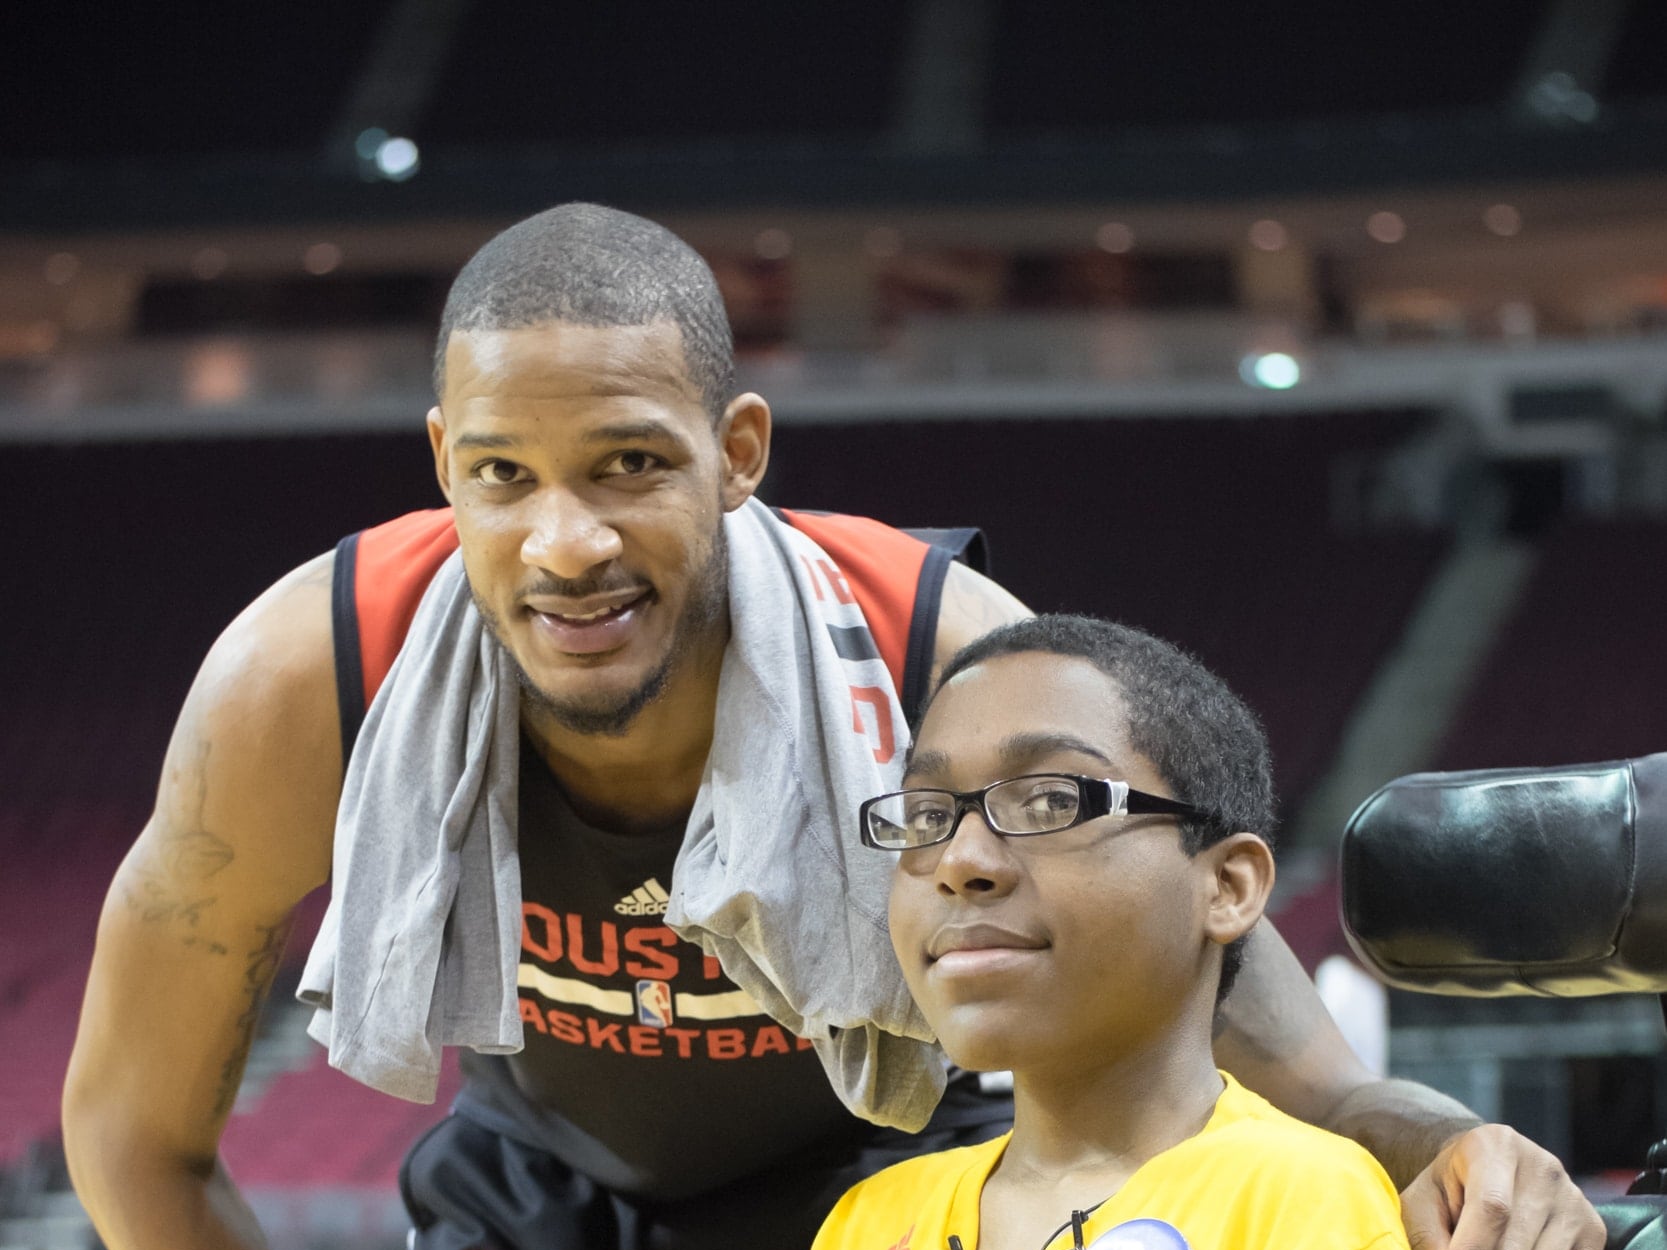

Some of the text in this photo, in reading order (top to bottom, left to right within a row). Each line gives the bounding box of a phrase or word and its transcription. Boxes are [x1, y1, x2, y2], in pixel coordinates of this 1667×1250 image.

[613, 902, 670, 916] adida
[521, 901, 720, 981] OUS
[517, 997, 816, 1060] ASKETBA
